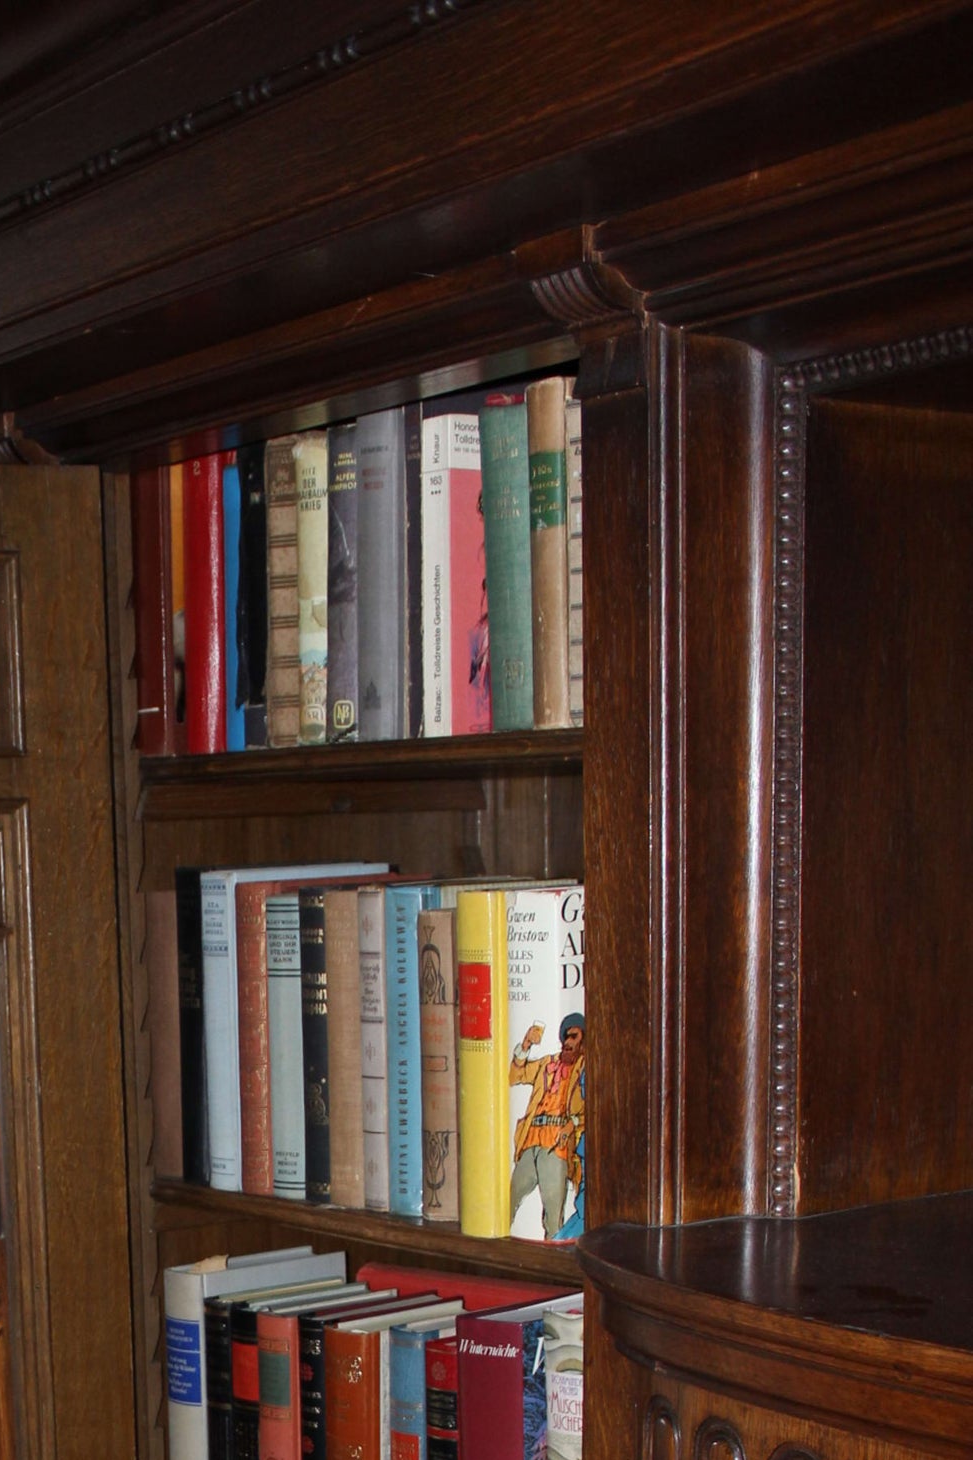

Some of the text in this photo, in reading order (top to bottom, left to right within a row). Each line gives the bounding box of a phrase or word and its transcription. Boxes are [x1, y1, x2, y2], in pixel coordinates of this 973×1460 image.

[434, 564, 442, 626] Geschichten
[434, 627, 442, 679] Tolldreiste
[507, 905, 536, 923] Gwen
[507, 925, 549, 942] Bristow
[458, 1338, 520, 1358] Winternächte
